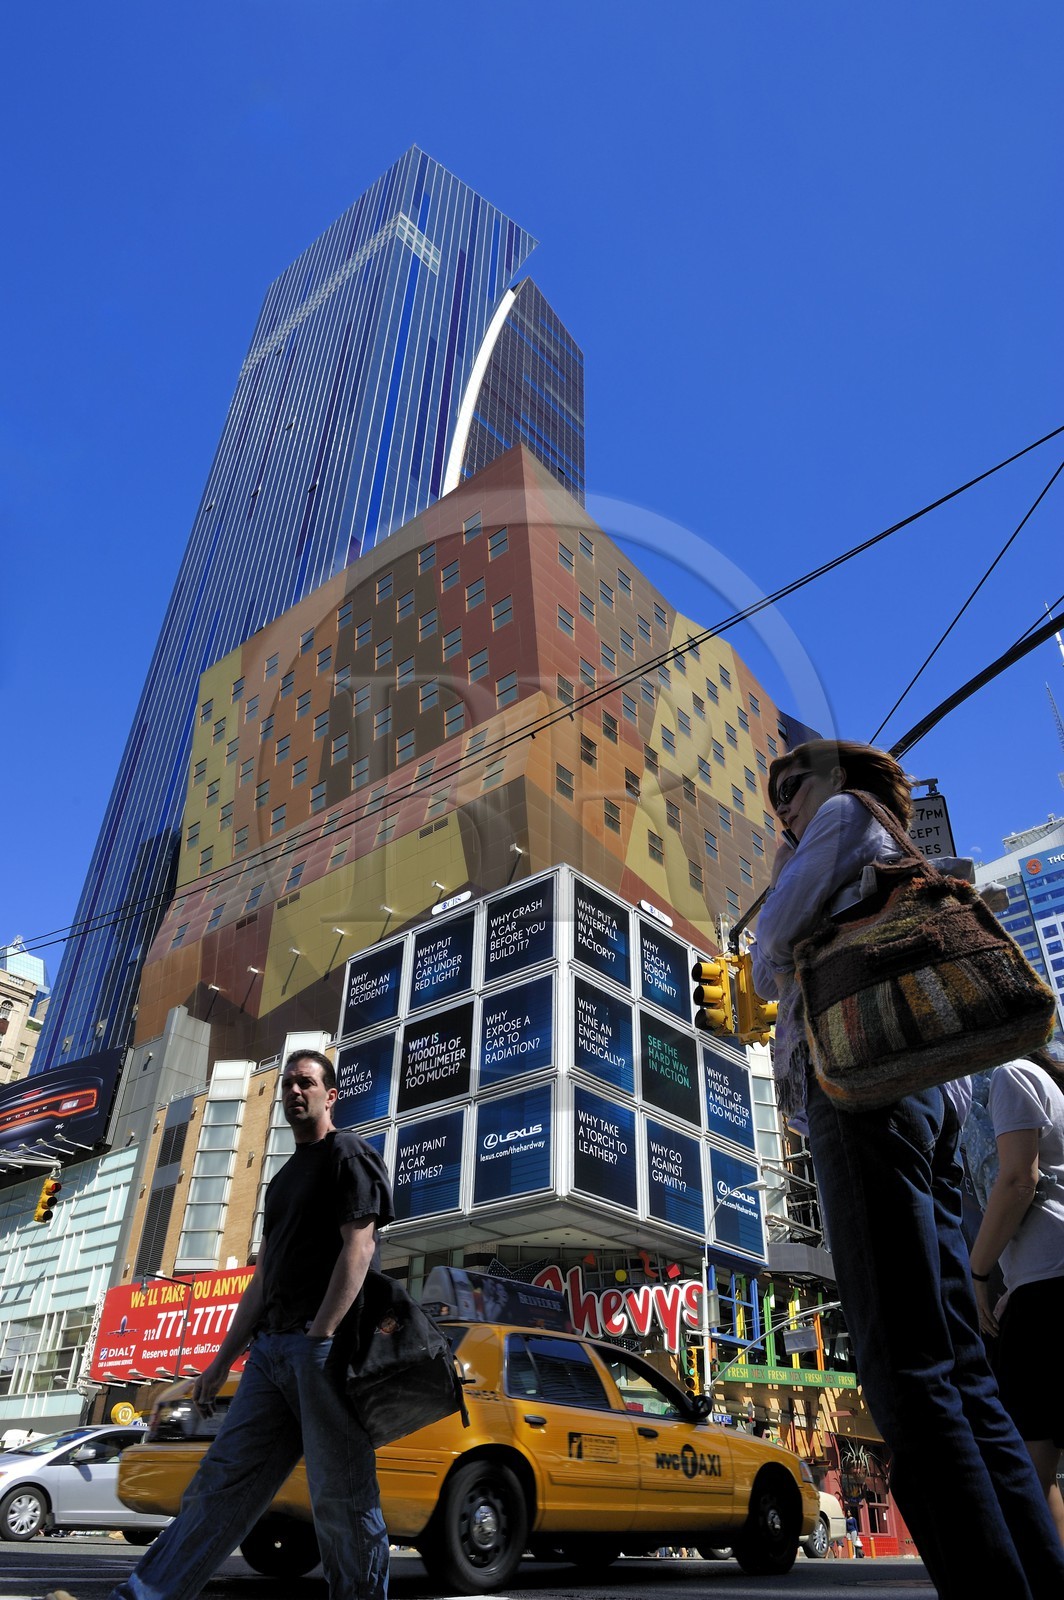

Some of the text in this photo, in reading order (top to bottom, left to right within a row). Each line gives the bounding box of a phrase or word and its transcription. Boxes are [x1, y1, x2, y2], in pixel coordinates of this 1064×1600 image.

[909, 826, 940, 839] CEPT
[918, 844, 942, 855] SES
[490, 899, 543, 928] WHY CRASH
[577, 897, 618, 930] WHY PUT A
[490, 921, 516, 939] A CAR
[490, 921, 546, 951] BEFORE YOU
[577, 910, 618, 942] WATERFALL
[577, 921, 594, 939] IN A
[417, 936, 452, 958] WHY PUT
[489, 940, 530, 963] BUILD IT?
[578, 935, 616, 963] FACTORY?
[642, 937, 659, 954] WHY
[415, 954, 463, 980] CAR UNDER
[416, 949, 448, 970] A SILVER
[642, 948, 672, 973] TEACH A
[644, 960, 667, 982] ROBOT
[350, 973, 390, 997] DESIGN AN
[351, 971, 369, 986] WHY
[414, 967, 460, 992] RED LIGHT?
[643, 971, 677, 998] TO PAINT?
[348, 985, 389, 1007] ACCIDENT?
[578, 997, 597, 1015] WHY
[486, 1010, 508, 1026] WHY
[486, 1015, 531, 1039] EXPOSE A
[577, 1010, 612, 1036] TUNE AN
[408, 1032, 439, 1051] WHY IS
[485, 1032, 520, 1052] CAR TO
[578, 1025, 609, 1049] ENGINE
[648, 1035, 678, 1058] SEE THE
[407, 1037, 462, 1063] 1/1000TH OF
[485, 1038, 540, 1064] RADIATION?
[578, 1037, 626, 1069] MUSICALLY?
[340, 1063, 359, 1077] WHY
[406, 1048, 466, 1077] A MILLIMETER
[648, 1048, 689, 1076] HARD WAY
[339, 1069, 372, 1088] WEAVE A
[405, 1063, 460, 1089] TOO MUCH?
[649, 1059, 692, 1089] IN ACTION.
[706, 1066, 730, 1086] WHY IS
[338, 1081, 373, 1100] CHASSIS?
[733, 1092, 742, 1104] OF
[709, 1091, 750, 1119] A MILLIMETER
[709, 1102, 747, 1129] TOO MUCH?
[499, 1124, 543, 1143] LEXUS
[577, 1110, 619, 1138] WHY TAKE
[400, 1136, 447, 1158] WHY PAINT
[480, 1140, 545, 1162] lexus.com/thehardway
[578, 1126, 628, 1155] A TORCH TO
[398, 1155, 425, 1171] A CAR
[578, 1140, 618, 1165] LEATHER?
[650, 1141, 682, 1164] WHY GO
[397, 1164, 443, 1186] SIX TIMES?
[651, 1155, 683, 1177] AGAINST
[651, 1169, 687, 1193] GRAVITY?
[727, 1187, 756, 1205] LEXUS
[131, 1274, 254, 1308] WE'LL TAKE OU ANYW
[143, 1329, 156, 1341] 212
[142, 1343, 222, 1359] Reserve onlne: dial7.co
[727, 1367, 749, 1379] FRESH
[768, 1370, 787, 1381] FRESH
[804, 1372, 822, 1383] FRESH
[838, 1375, 854, 1386] FRESH
[655, 1449, 721, 1477] NYC TAXI
